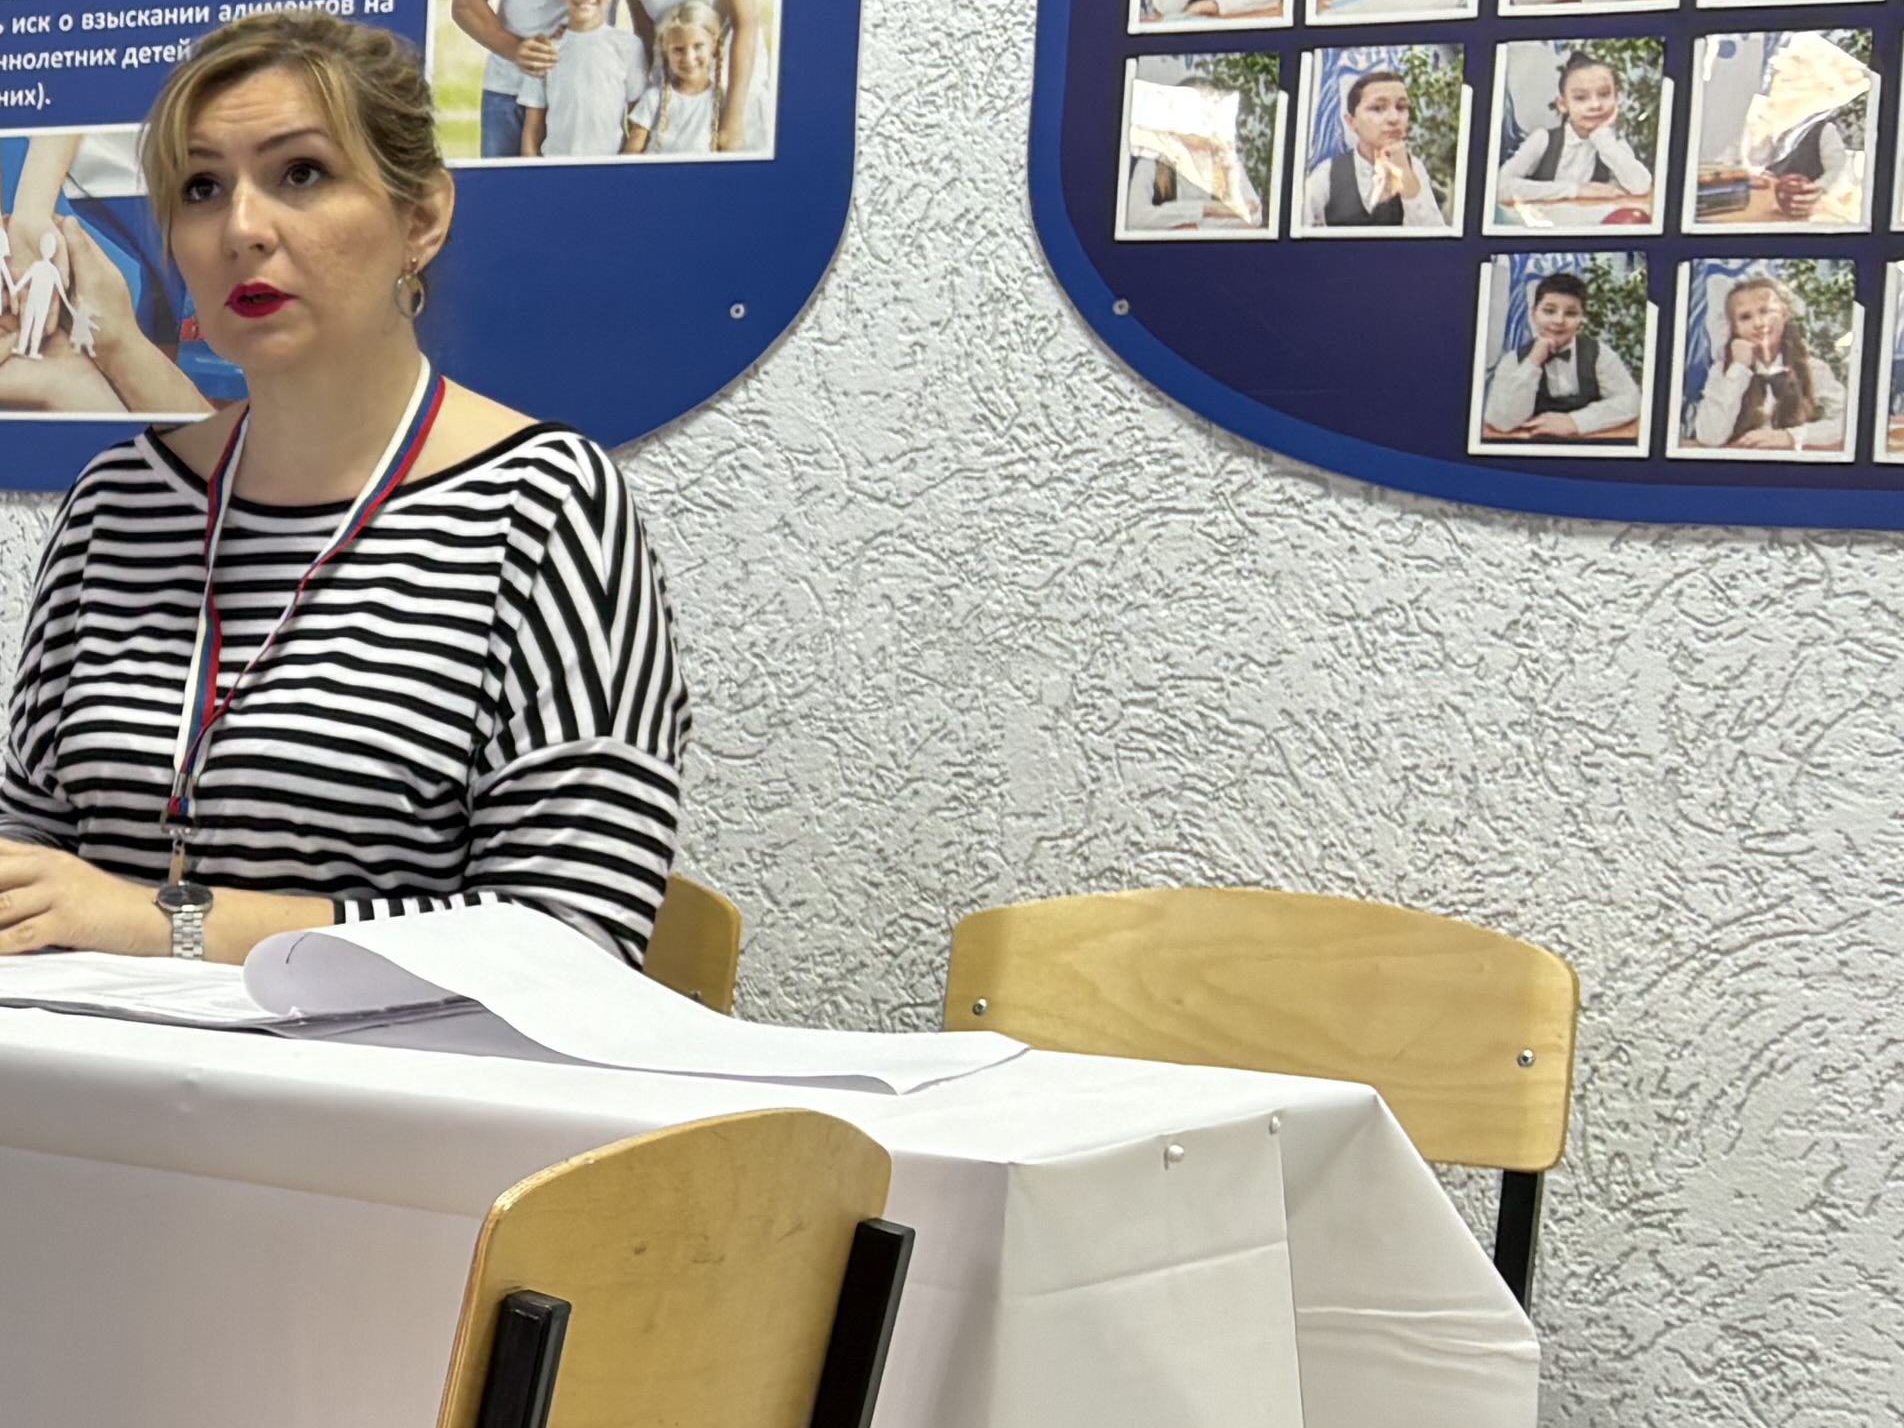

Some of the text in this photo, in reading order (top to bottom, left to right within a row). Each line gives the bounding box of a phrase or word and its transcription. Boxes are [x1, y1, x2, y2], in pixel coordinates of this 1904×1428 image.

[12, 15, 51, 34] иск
[58, 14, 73, 32] о
[81, 6, 210, 30] взыскании
[121, 41, 192, 66] детей
